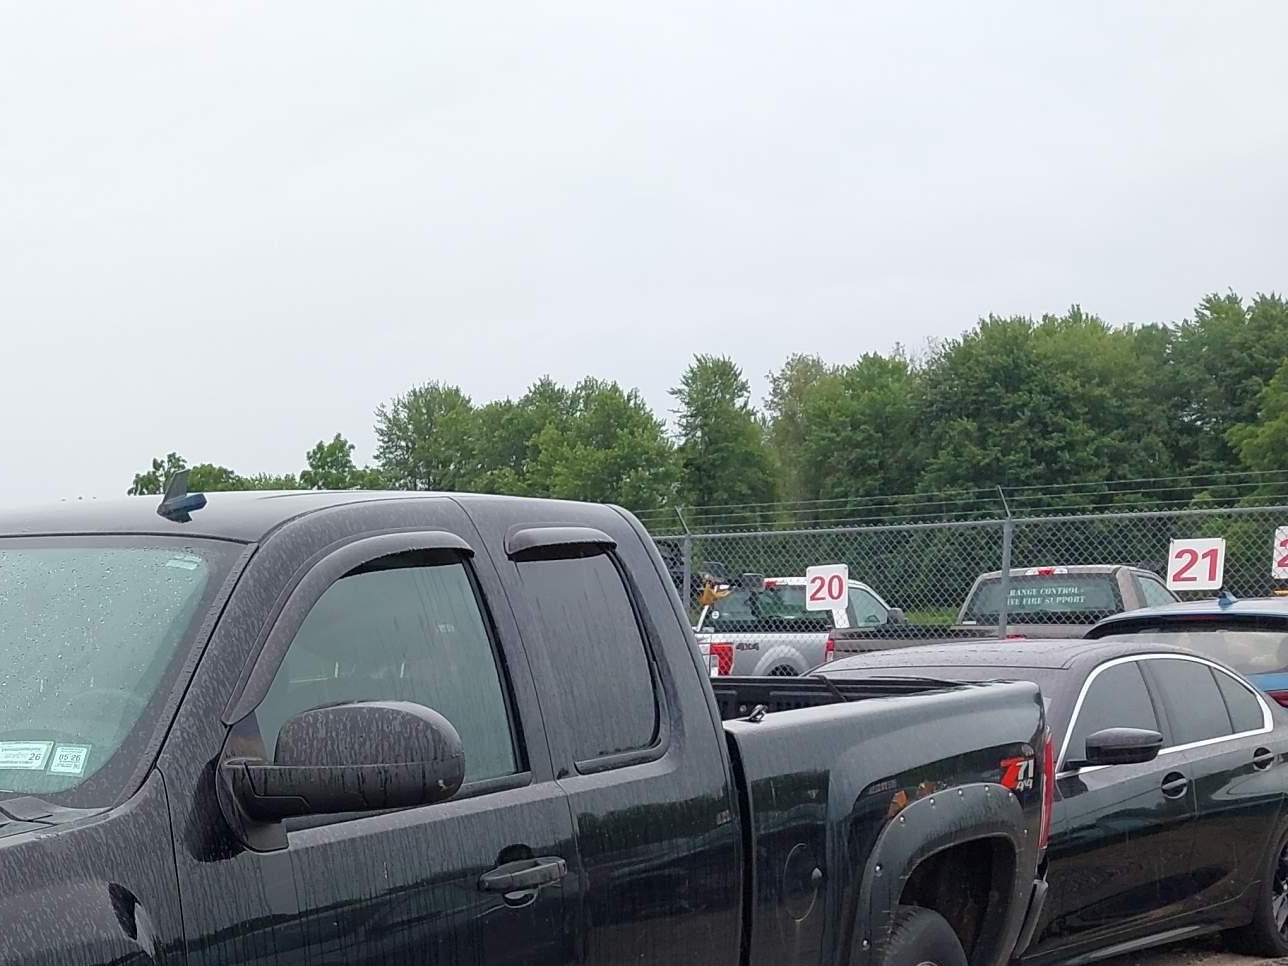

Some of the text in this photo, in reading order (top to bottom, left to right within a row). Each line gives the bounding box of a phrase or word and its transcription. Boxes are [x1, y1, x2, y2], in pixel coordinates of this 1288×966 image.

[1172, 548, 1219, 582] 21
[809, 574, 844, 601] 20
[28, 752, 41, 761] 26
